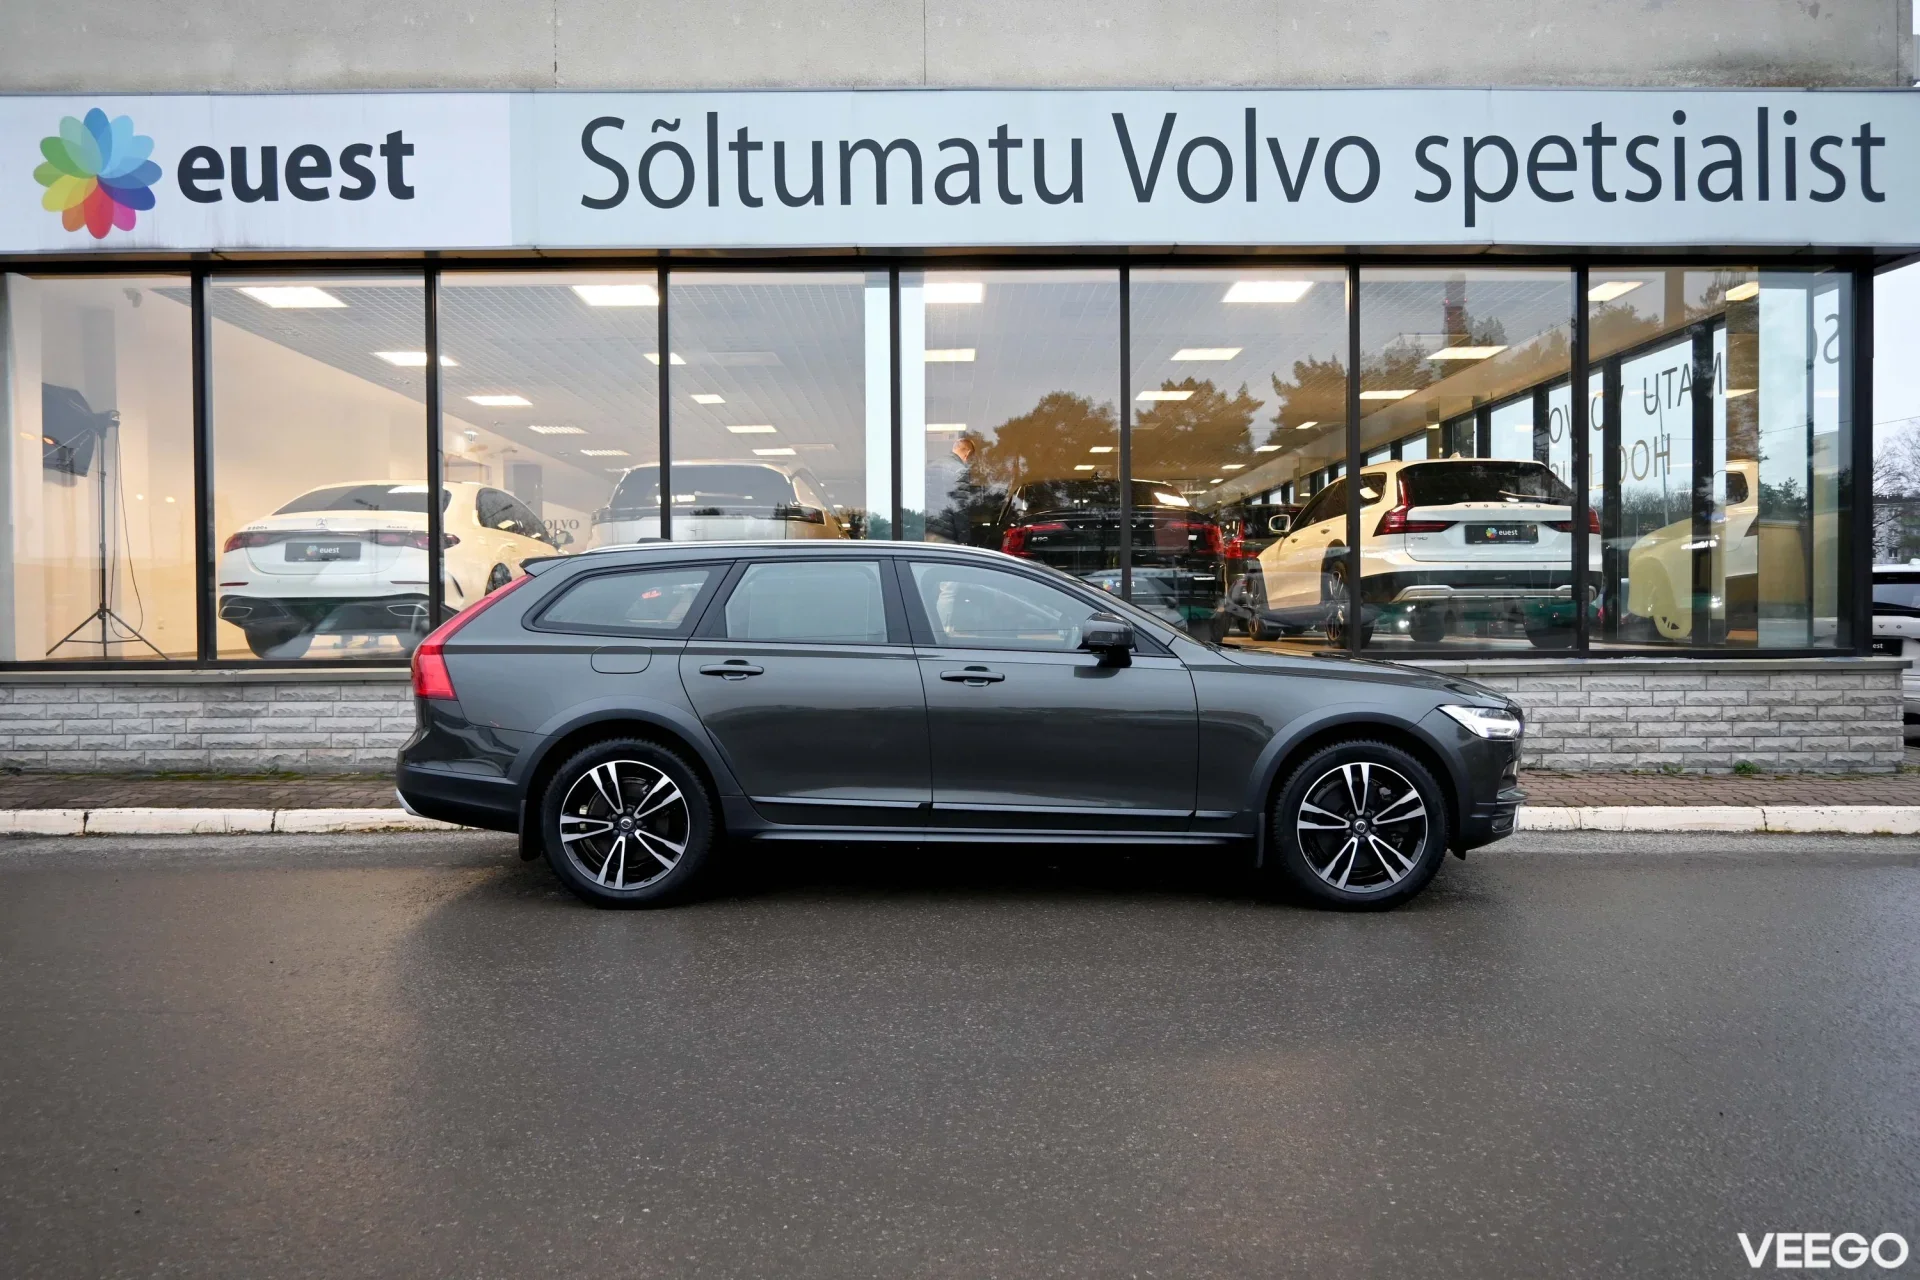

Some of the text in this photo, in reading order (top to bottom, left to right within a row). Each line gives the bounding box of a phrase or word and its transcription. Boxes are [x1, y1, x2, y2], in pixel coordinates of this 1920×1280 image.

[177, 129, 415, 204] euest
[580, 106, 1886, 228] Sõltumatu Volvo spetsialist
[543, 519, 580, 531] OLVO
[1498, 528, 1519, 536] euest
[319, 546, 340, 554] euest
